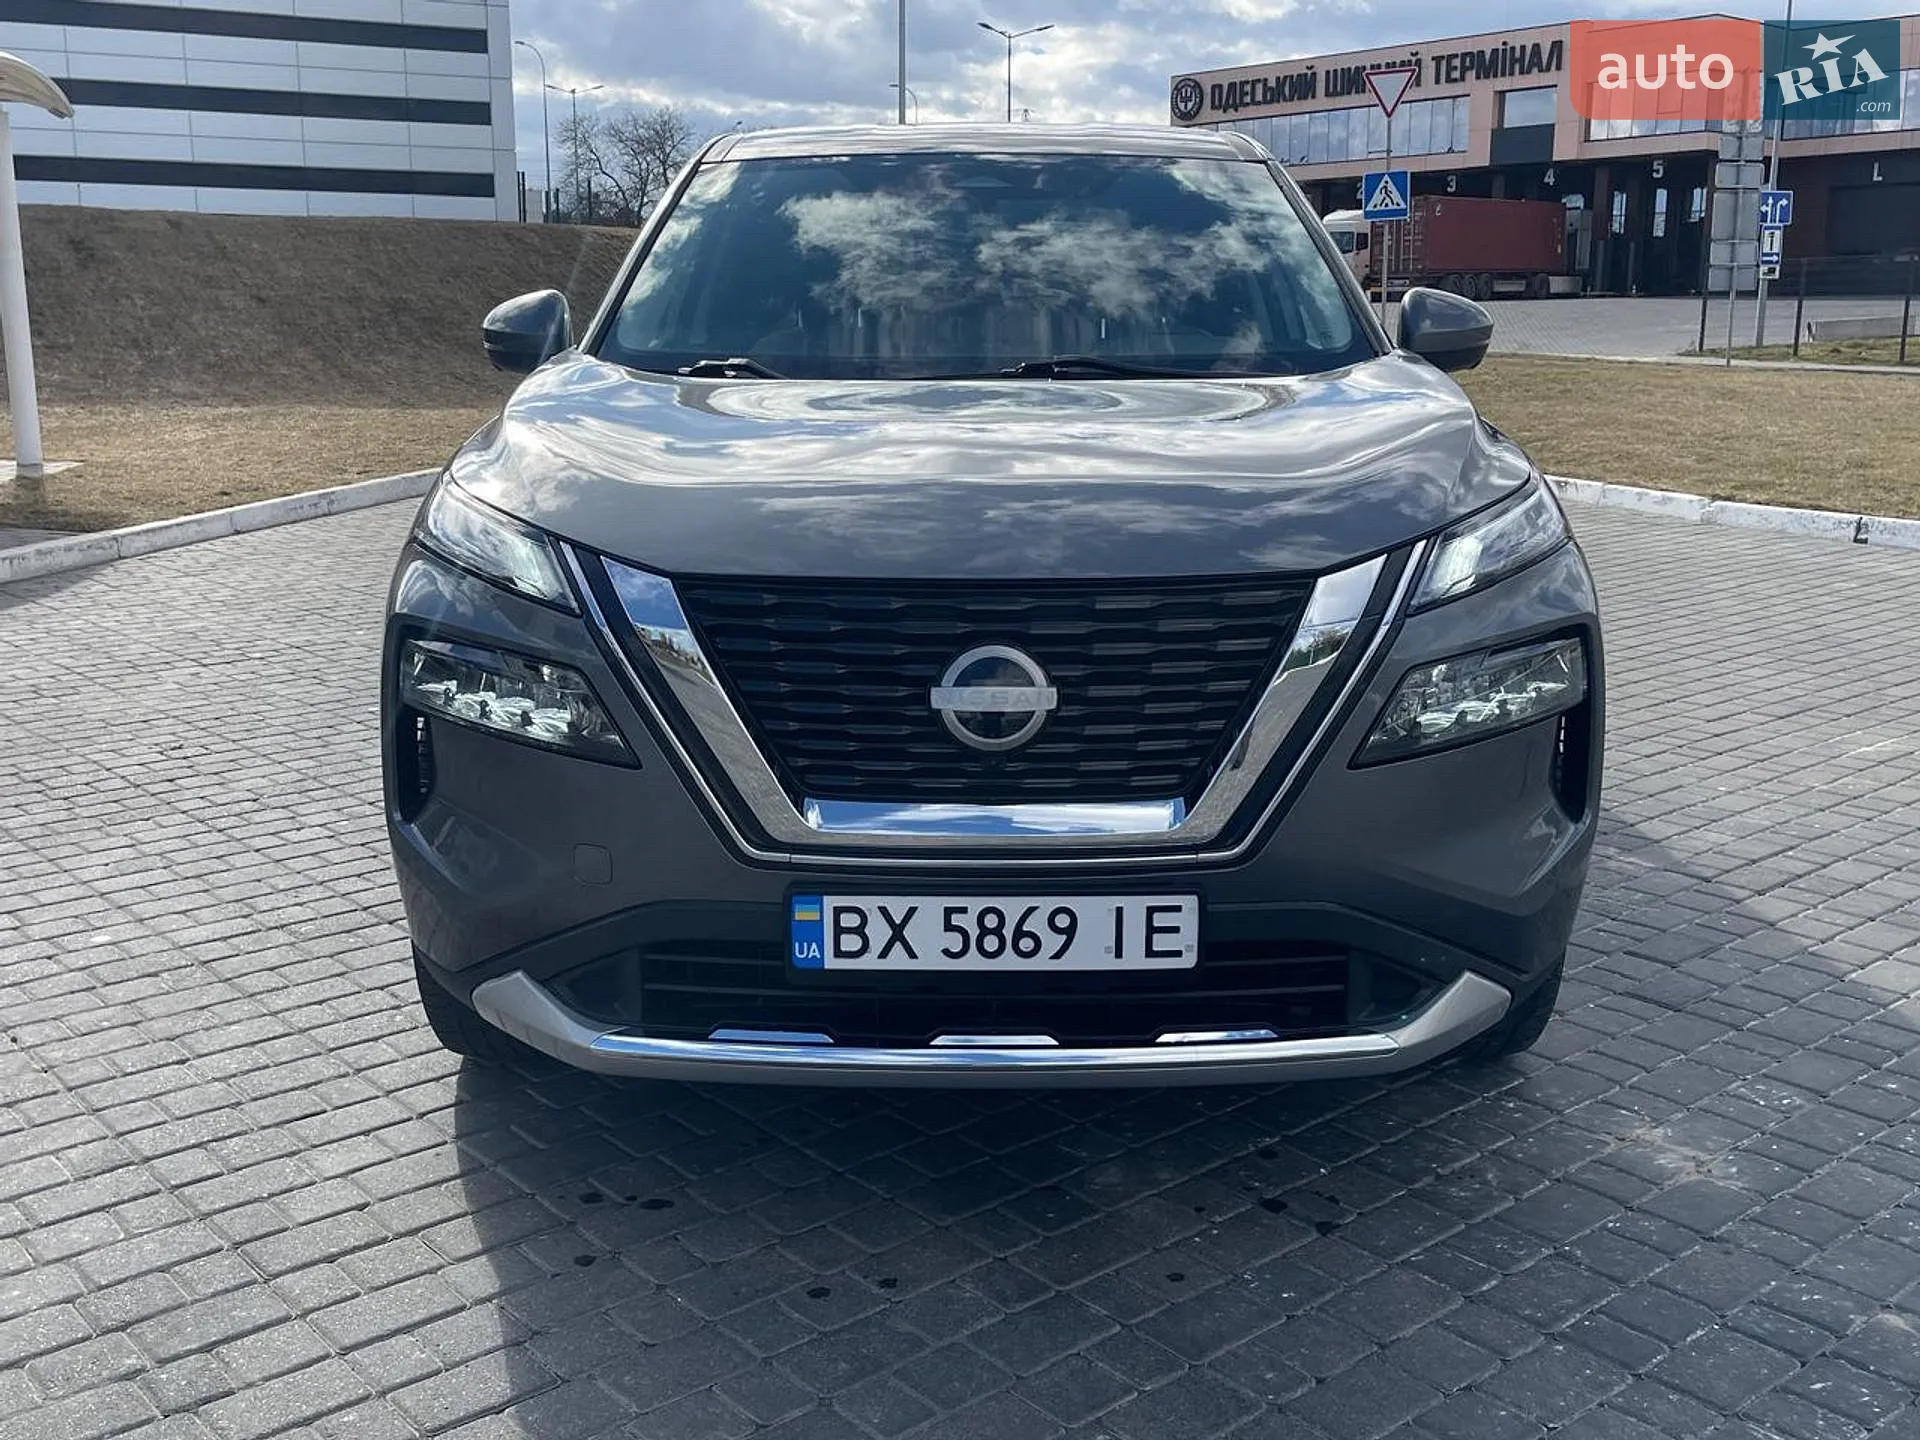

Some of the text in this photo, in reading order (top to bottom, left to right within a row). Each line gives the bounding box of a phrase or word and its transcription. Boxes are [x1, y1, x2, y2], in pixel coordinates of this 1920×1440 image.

[1210, 64, 1317, 113] ОДЕСЬКИЙ
[1324, 51, 1422, 98] ШИЙ
[1431, 39, 1564, 85] ТЕРМІНАЛ
[1543, 168, 1556, 186] 4
[1652, 160, 1665, 179] 5
[1446, 175, 1457, 193] 3
[832, 905, 1183, 960] BX 5869 IE
[795, 942, 821, 959] UA
